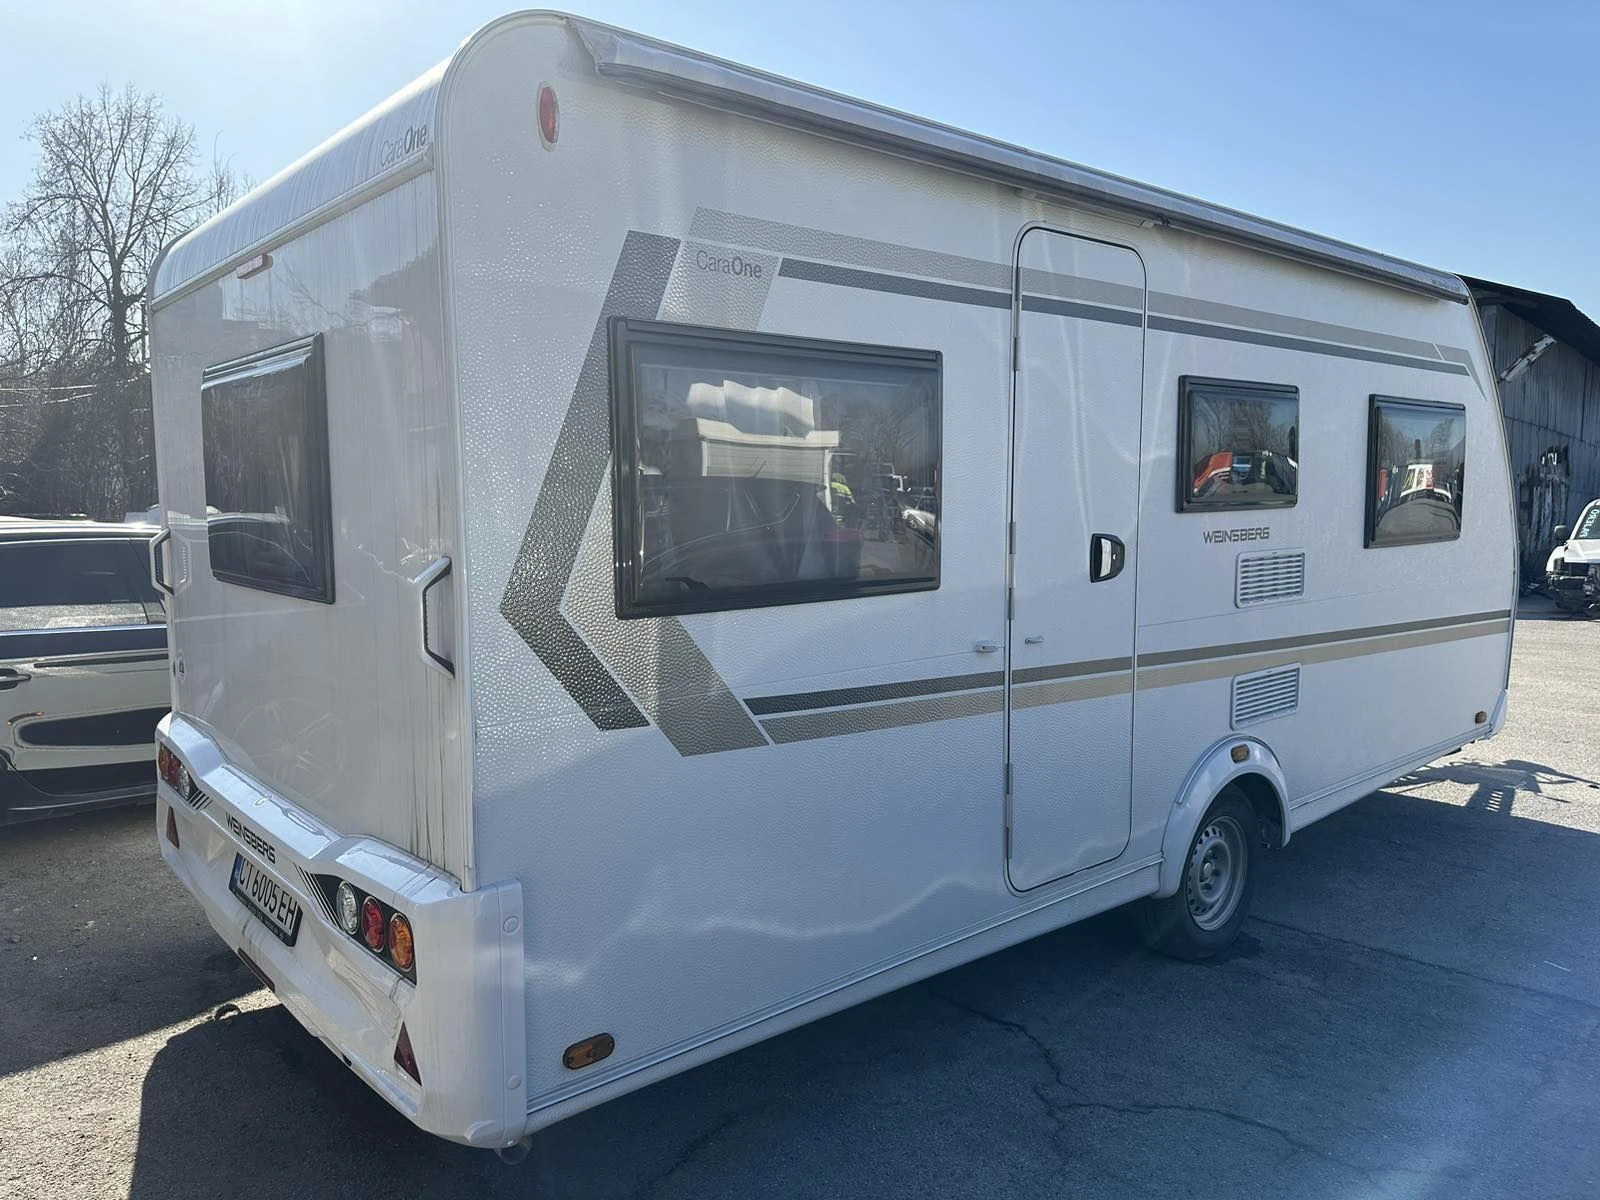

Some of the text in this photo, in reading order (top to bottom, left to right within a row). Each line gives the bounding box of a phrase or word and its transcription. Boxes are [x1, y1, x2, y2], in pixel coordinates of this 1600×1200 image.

[380, 124, 427, 167] CaraOne
[696, 250, 762, 279] CaraOne
[1203, 527, 1270, 544] WEINSBERG
[225, 811, 276, 864] WEINSBERG
[252, 870, 280, 914] 6005
[276, 890, 298, 931] EH
